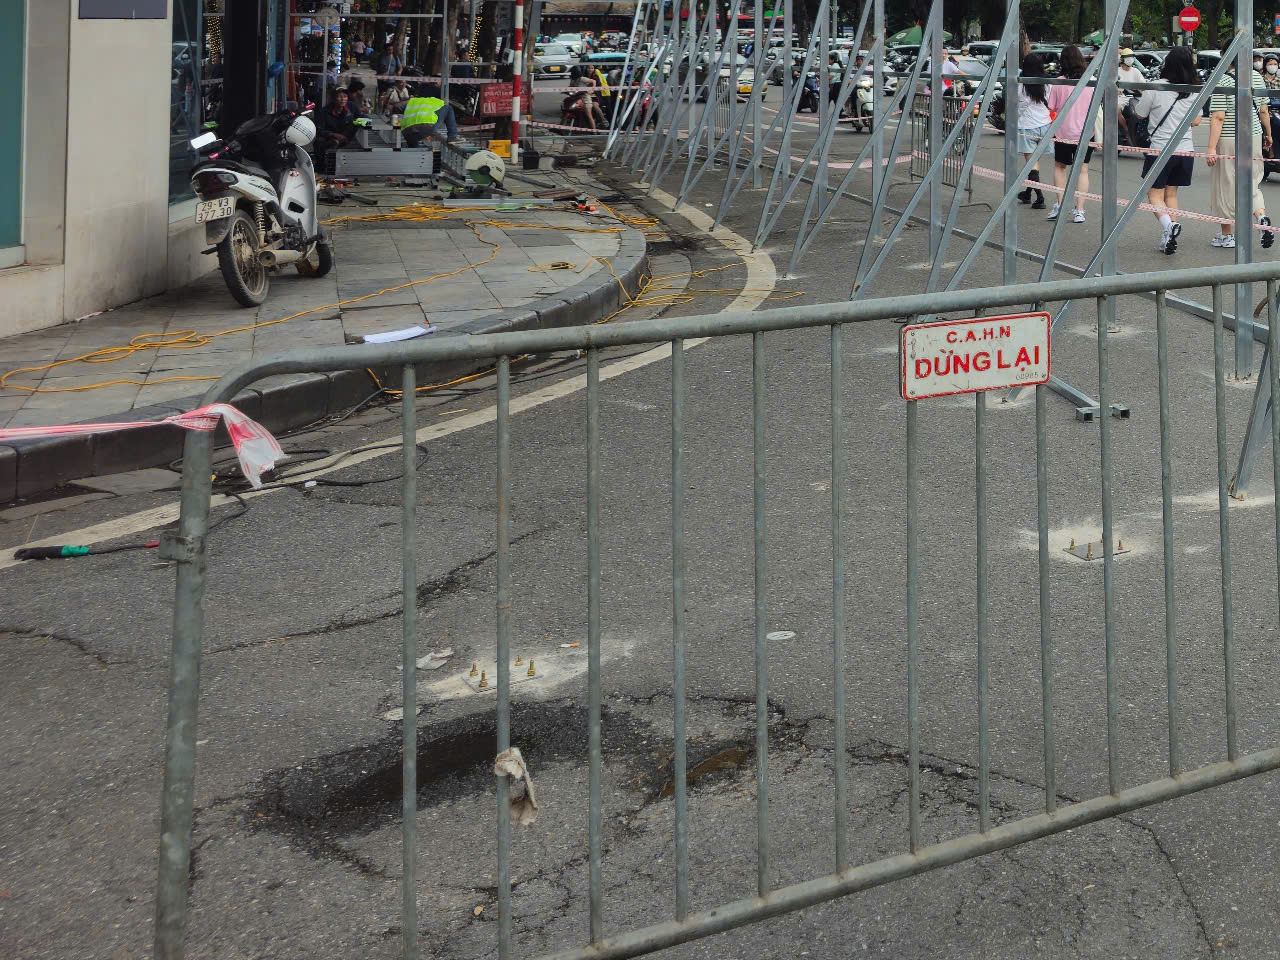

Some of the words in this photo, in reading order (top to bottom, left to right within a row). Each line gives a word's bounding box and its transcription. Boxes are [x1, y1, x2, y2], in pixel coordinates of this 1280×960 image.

[202, 198, 229, 212] 29-V3
[198, 207, 232, 222] 377.30
[946, 325, 1011, 344] C.A.H.N
[914, 348, 991, 379] DỪNG
[997, 345, 1040, 372] LẠI
